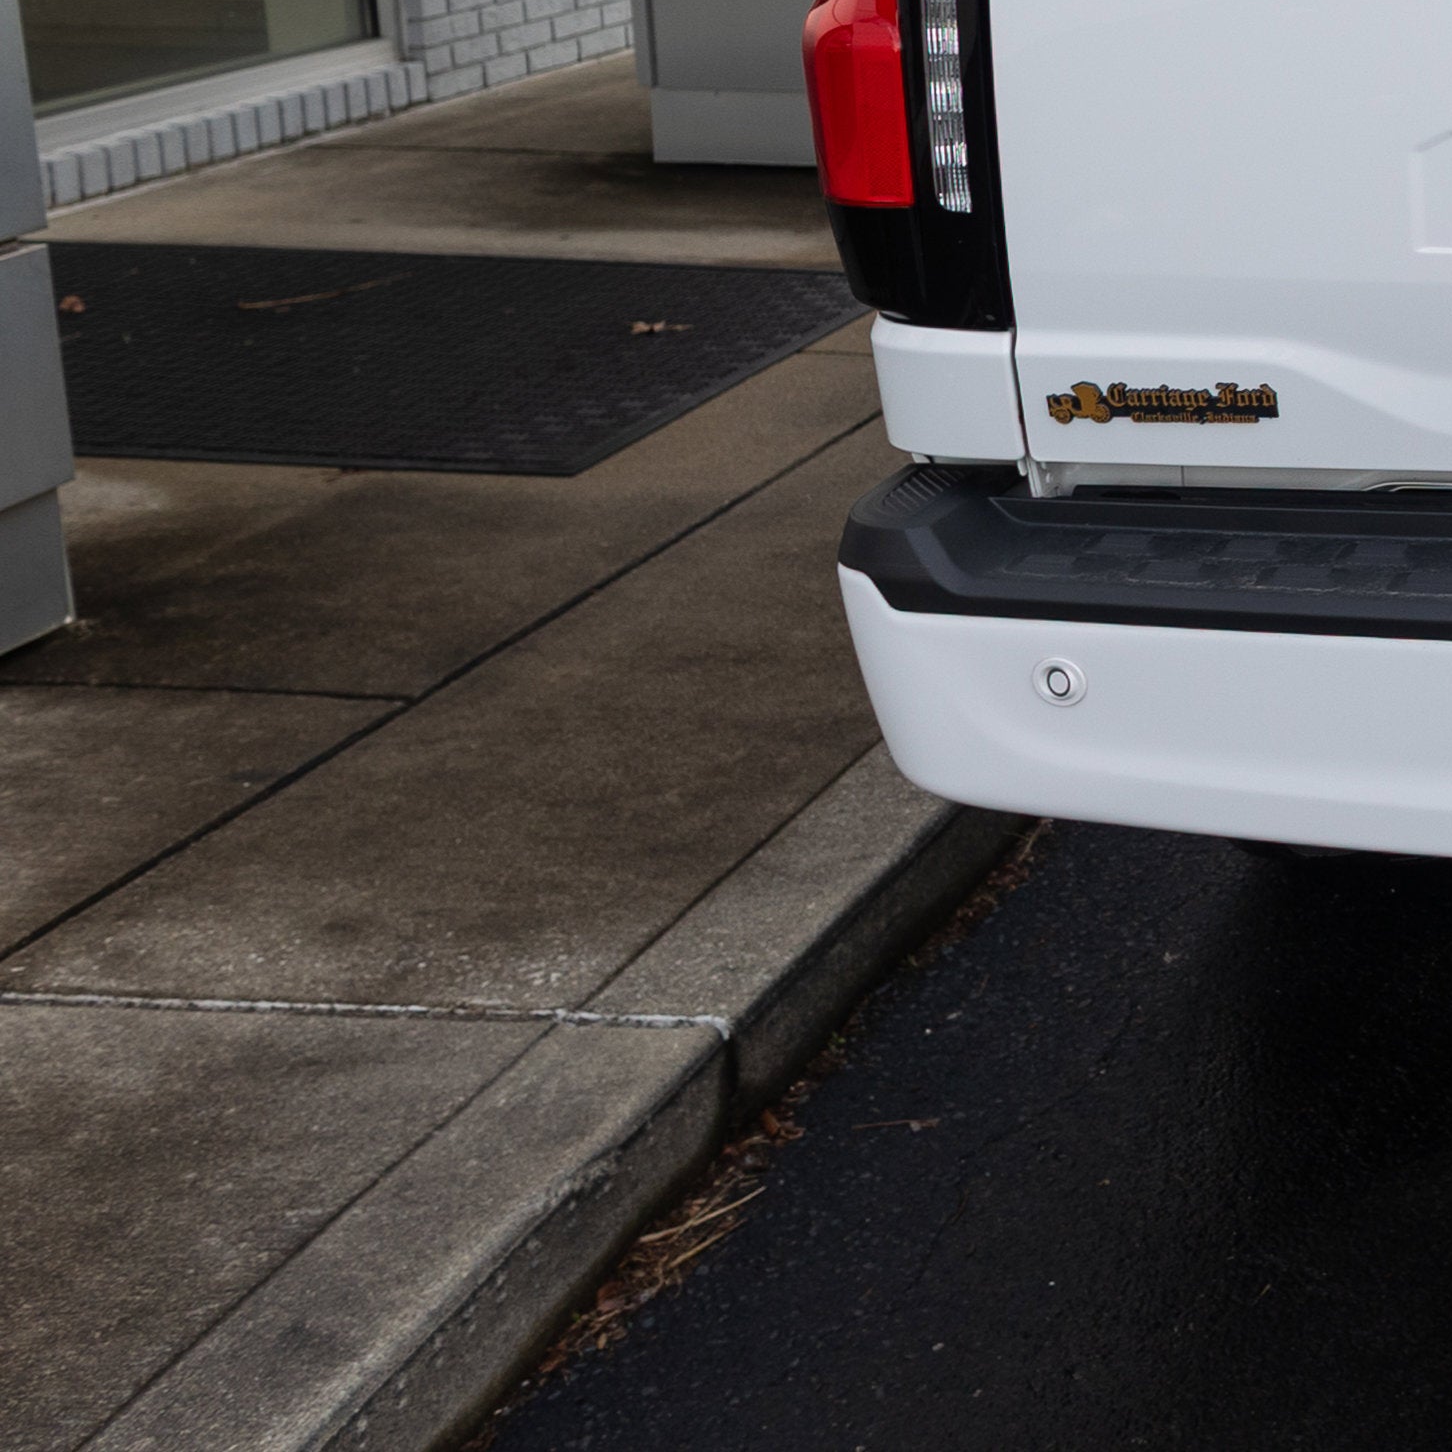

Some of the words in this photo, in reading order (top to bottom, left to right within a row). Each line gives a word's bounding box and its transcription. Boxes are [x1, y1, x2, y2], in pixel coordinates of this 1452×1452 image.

[1106, 382, 1209, 411] Carriage
[1214, 382, 1277, 409] Ford
[1205, 411, 1258, 423] Indiana
